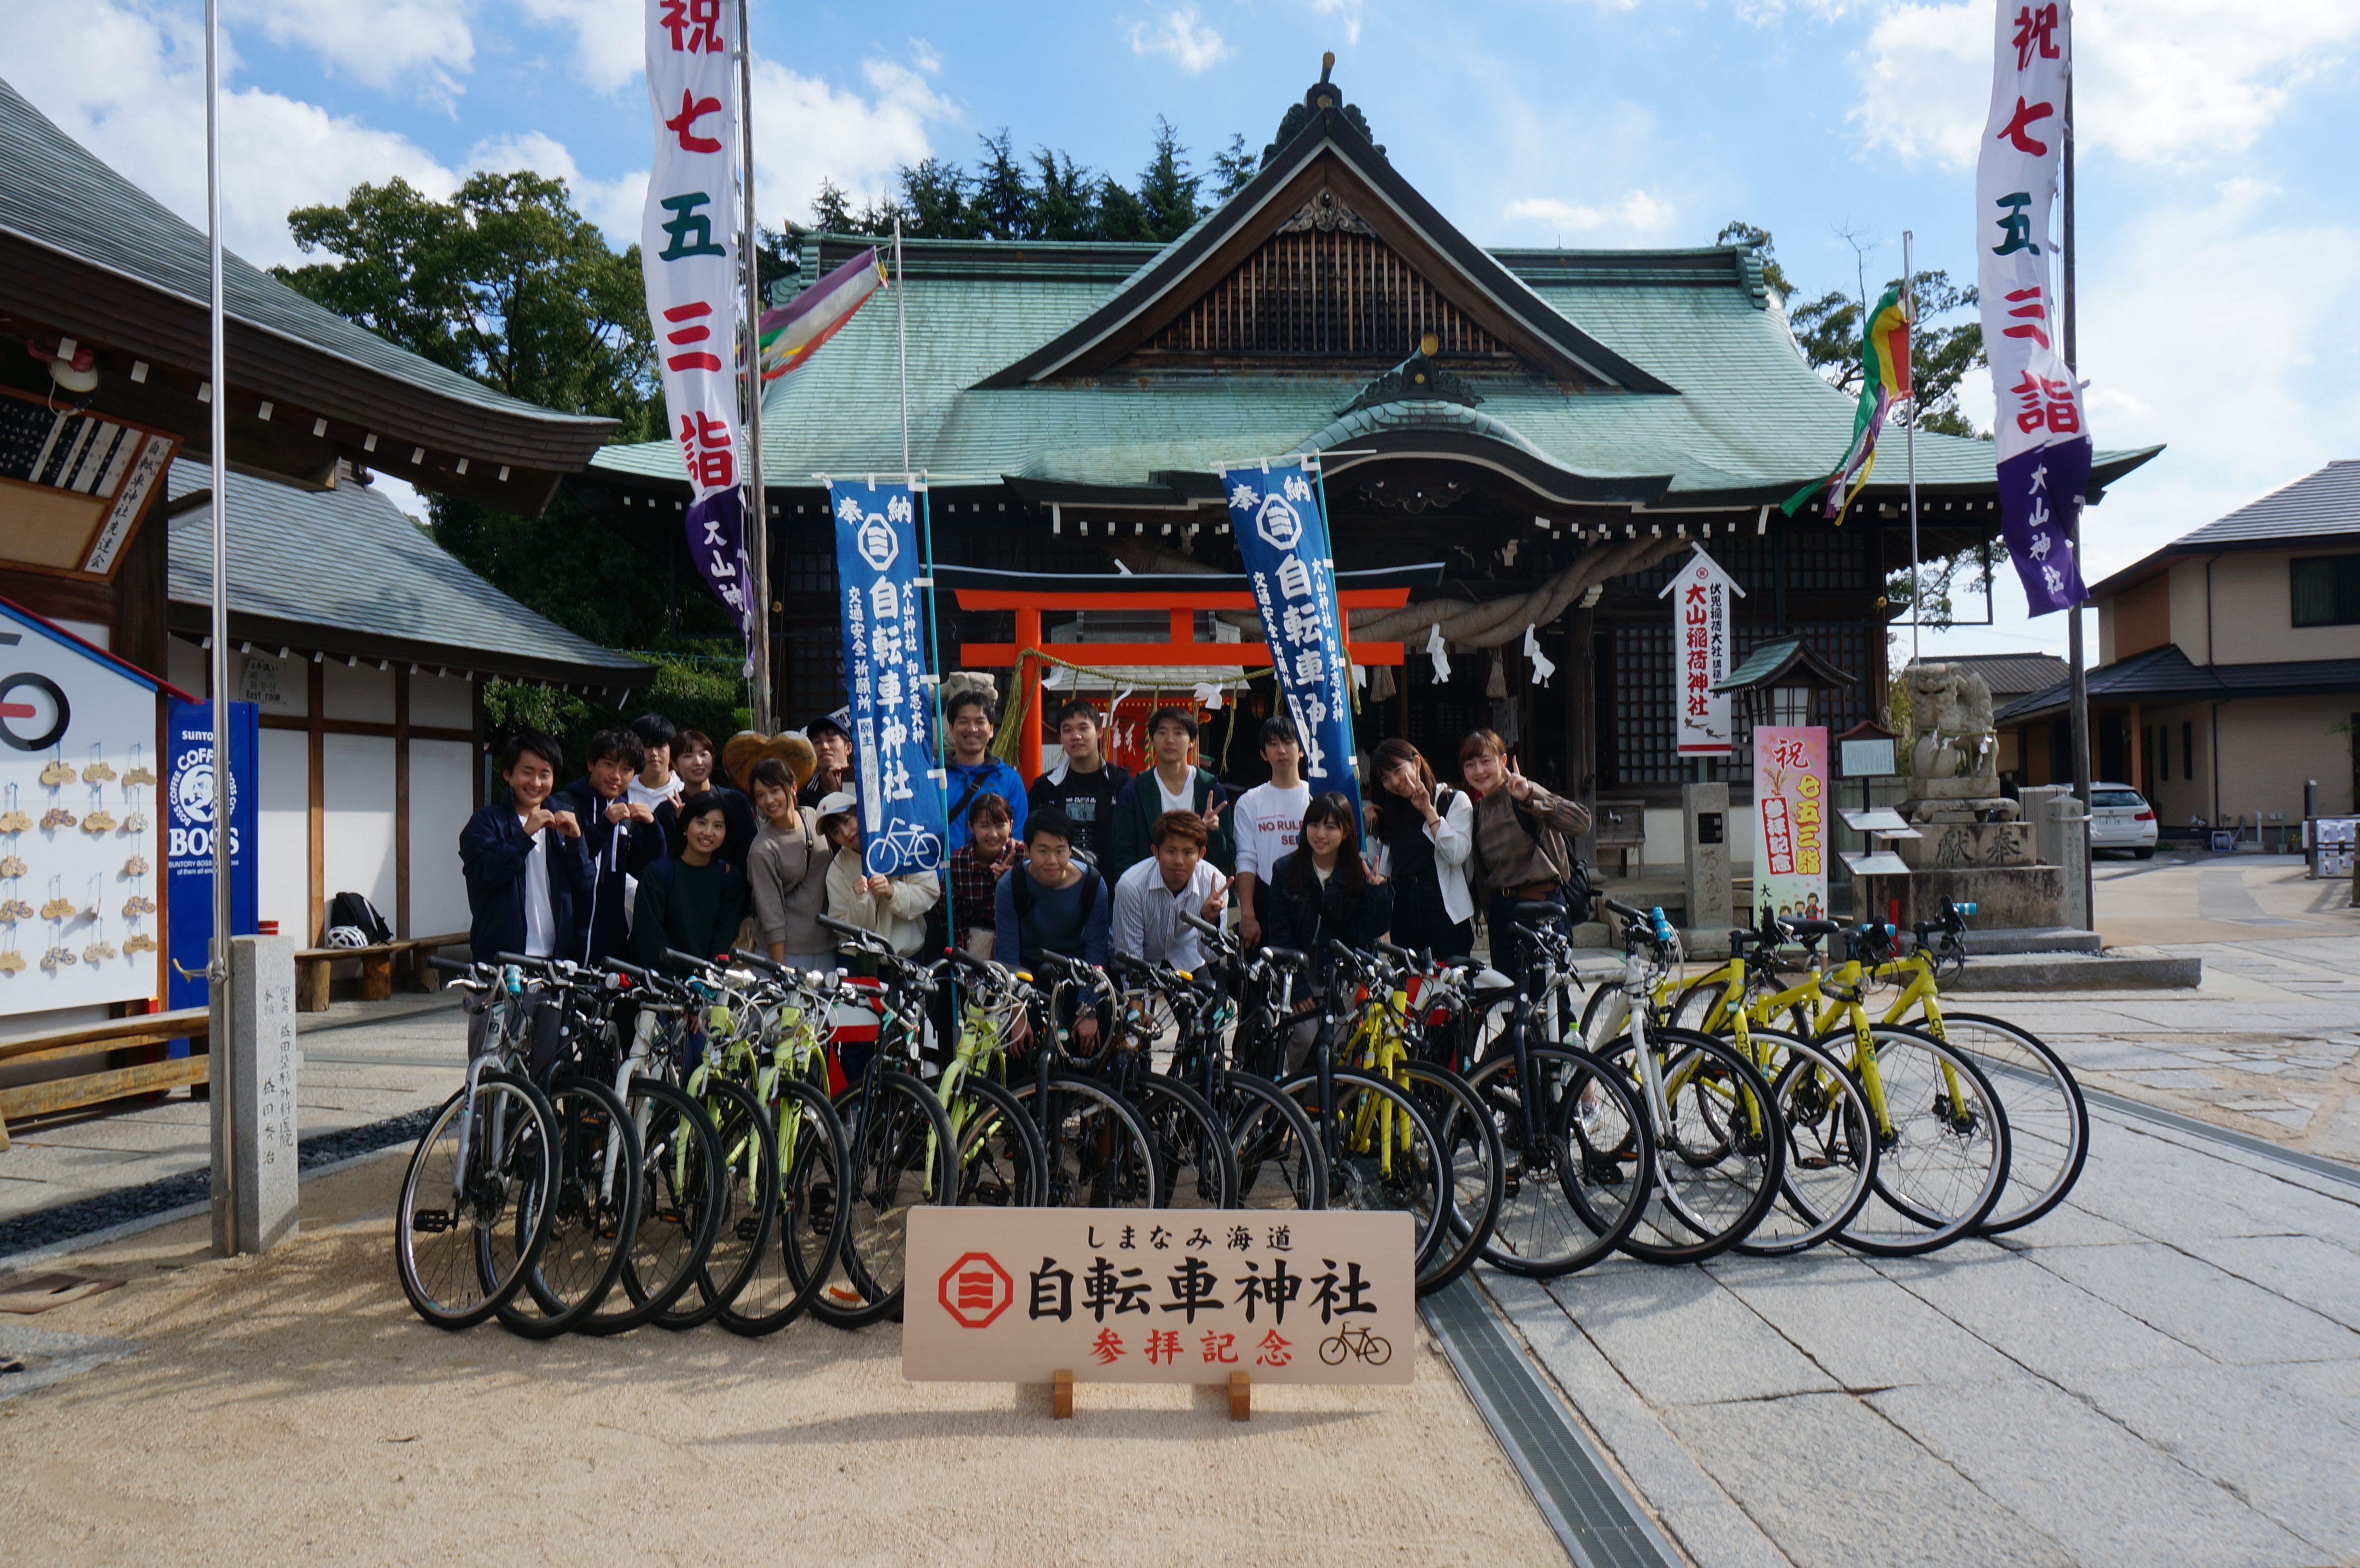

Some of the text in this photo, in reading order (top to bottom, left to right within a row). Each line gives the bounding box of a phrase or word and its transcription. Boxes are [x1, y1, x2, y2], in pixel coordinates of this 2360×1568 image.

[658, 0, 733, 487] 祝七五三詣
[1992, 2, 2079, 434] 祝七五三詣
[837, 495, 912, 525] 奉納
[1229, 475, 1311, 512] 奉納
[2028, 463, 2065, 596] 大山神社
[903, 580, 918, 652] 大山神社
[1312, 557, 1333, 629] 大山神社
[848, 585, 871, 711] 交通安全 祈願所
[1253, 571, 1293, 690] 交通安全 祈願所
[1685, 582, 1709, 716] 大山稲荷神社
[246, 689, 281, 702] Rest room
[869, 576, 913, 803] 自転車神社
[177, 747, 214, 771] COFF
[182, 730, 214, 742] SUNTO
[860, 722, 873, 747] 願主
[1773, 737, 1810, 771] 祝
[229, 771, 237, 796] OSS
[1257, 819, 1303, 833] NO RULE
[1764, 798, 1792, 873] 参拝記念
[1795, 773, 1821, 875] 七五三詣
[1089, 1224, 1295, 1252] しまなみ海道
[1027, 1255, 1378, 1325] 自転車神社
[1089, 1327, 1294, 1367] 参拝記念
